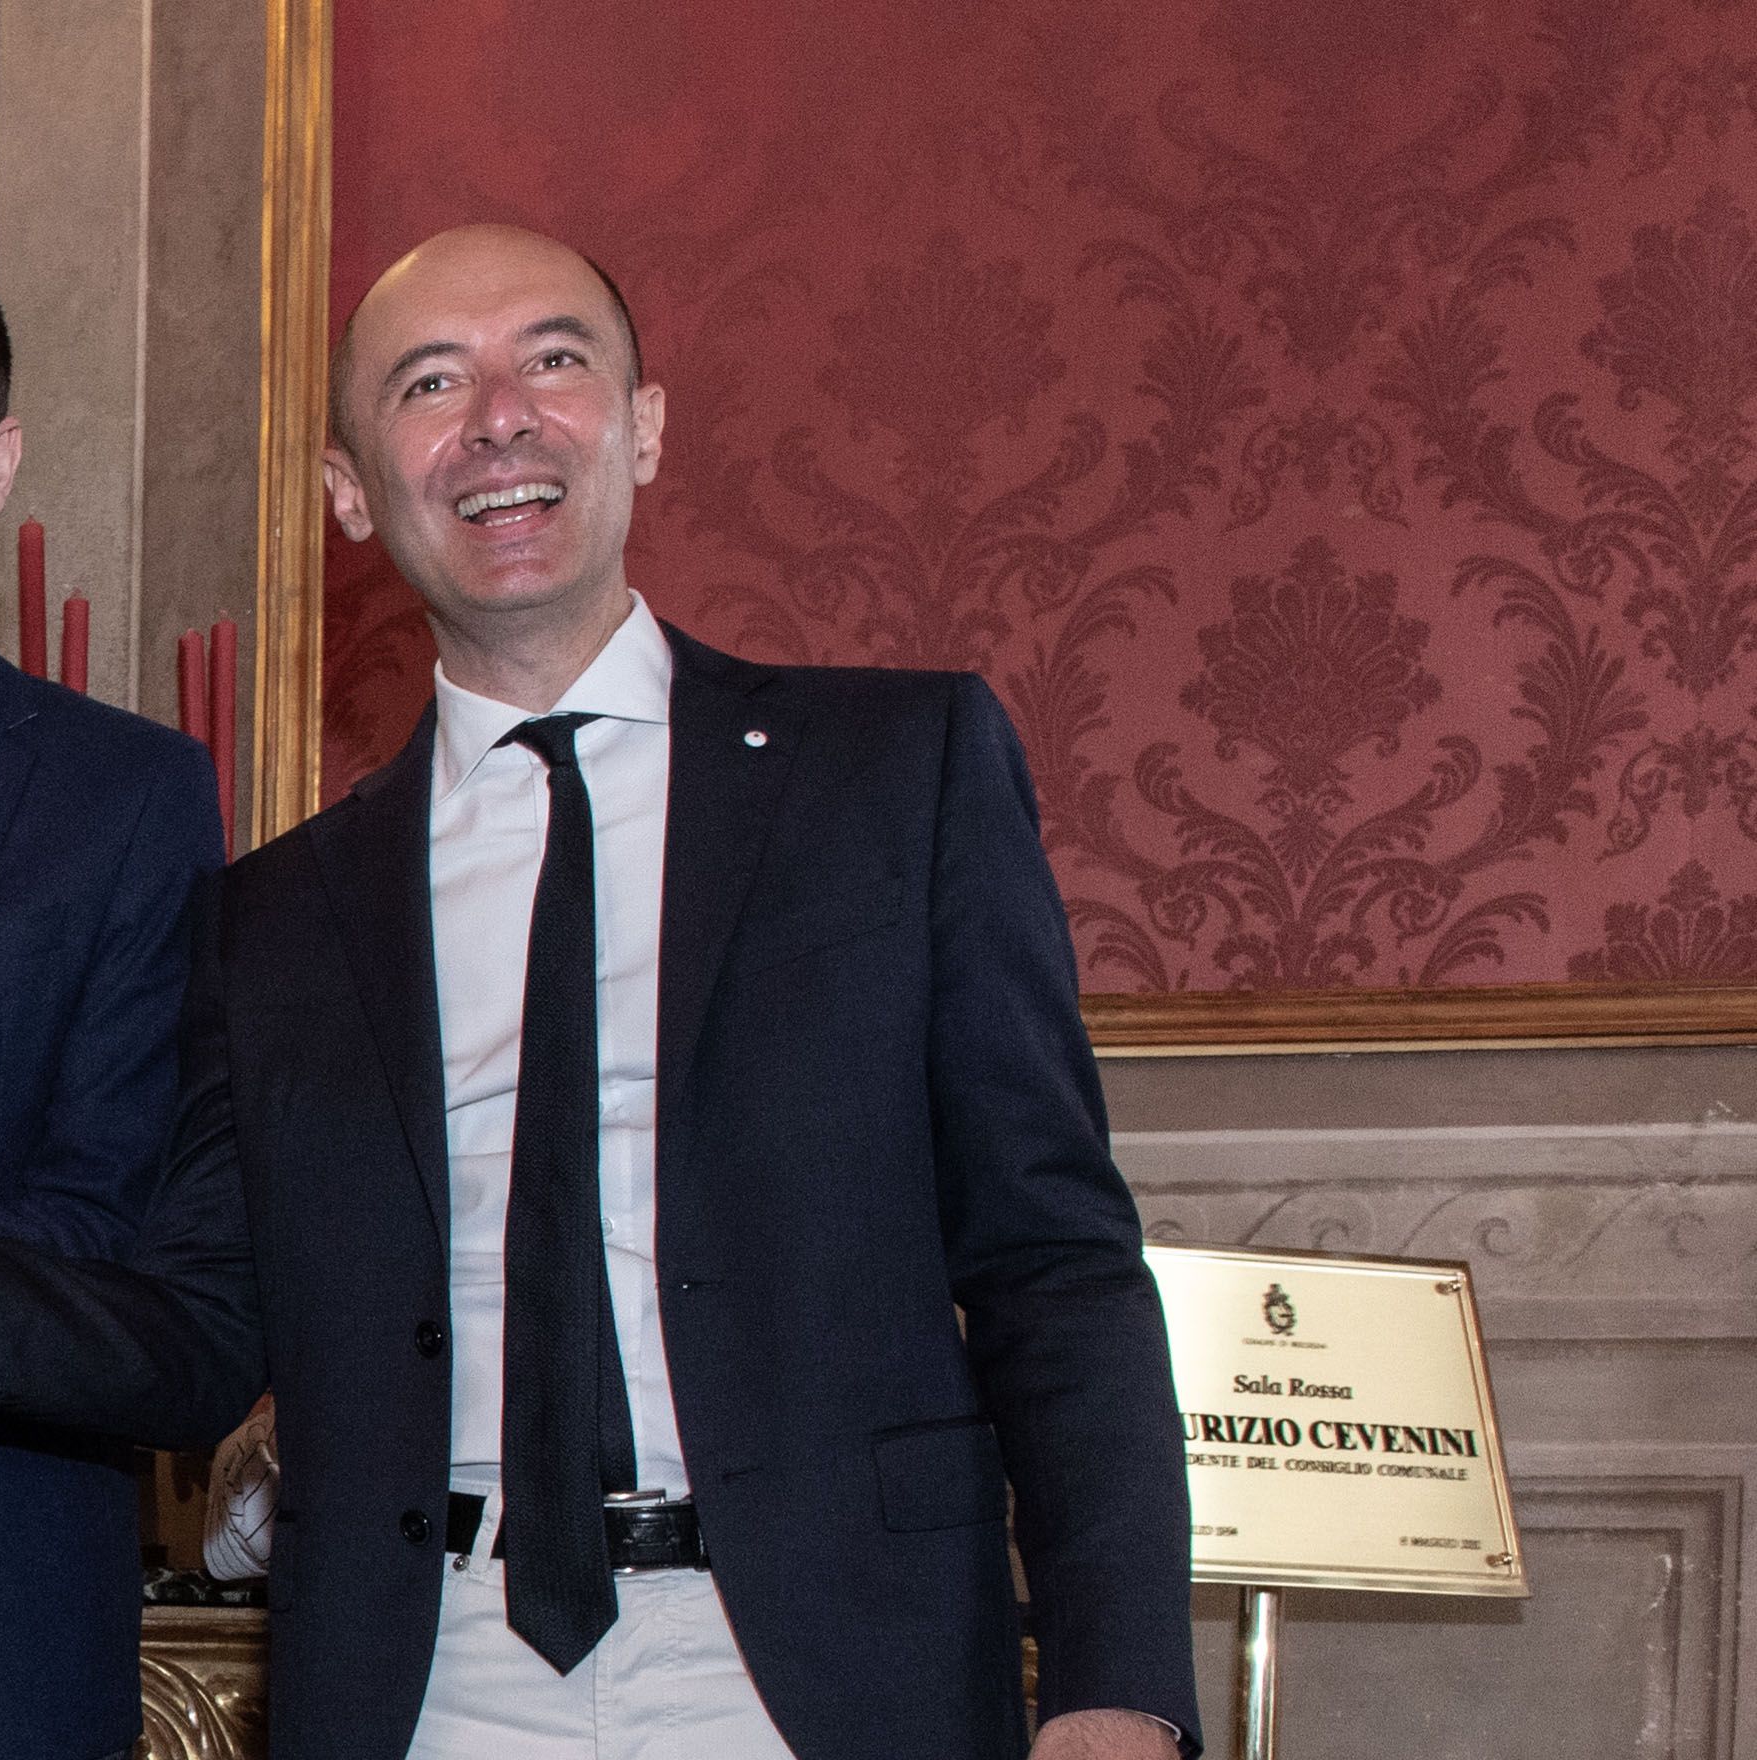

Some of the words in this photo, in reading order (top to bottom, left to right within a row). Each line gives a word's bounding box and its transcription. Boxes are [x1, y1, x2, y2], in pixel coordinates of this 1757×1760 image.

[1233, 1374, 1283, 1396] Sala
[1288, 1378, 1353, 1400] Rossa
[1308, 1420, 1479, 1457] CEVENINI
[1247, 1456, 1280, 1470] DEL
[1285, 1458, 1373, 1475] CONSIGLIO
[1377, 1463, 1469, 1481] COMUNALE
